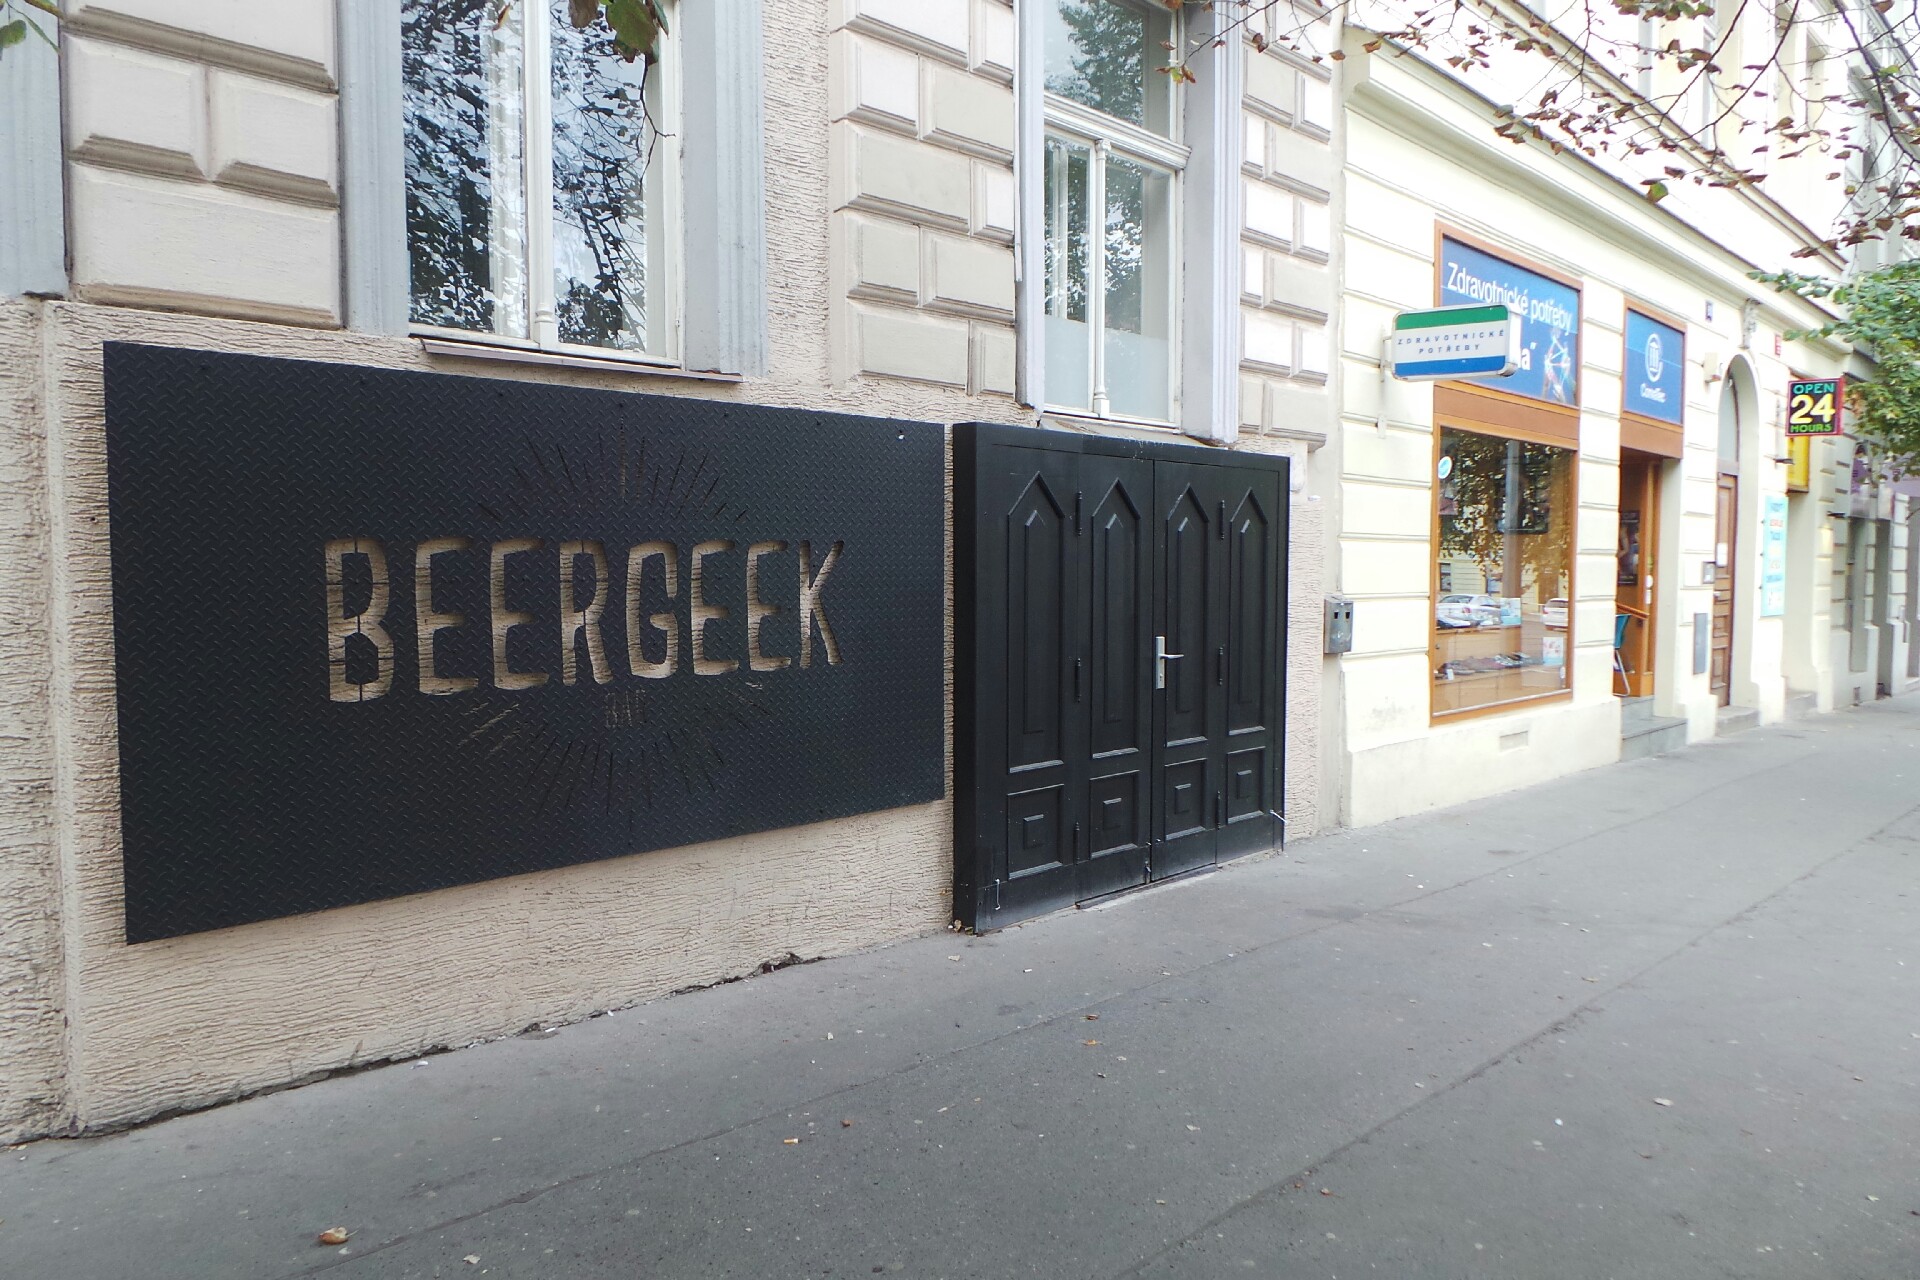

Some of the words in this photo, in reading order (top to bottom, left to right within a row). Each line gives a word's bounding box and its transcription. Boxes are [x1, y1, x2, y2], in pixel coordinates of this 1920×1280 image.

[1448, 261, 1528, 315] Zdravotnické
[1531, 299, 1573, 335] potřeby
[1397, 328, 1505, 345] ZDRAVOTNICKÉ
[1418, 344, 1480, 354] POTŘEBY
[1793, 383, 1835, 394] OPEN
[1790, 394, 1836, 424] 24
[1790, 424, 1832, 433] HOURS
[326, 538, 843, 703] BEERGEEK
